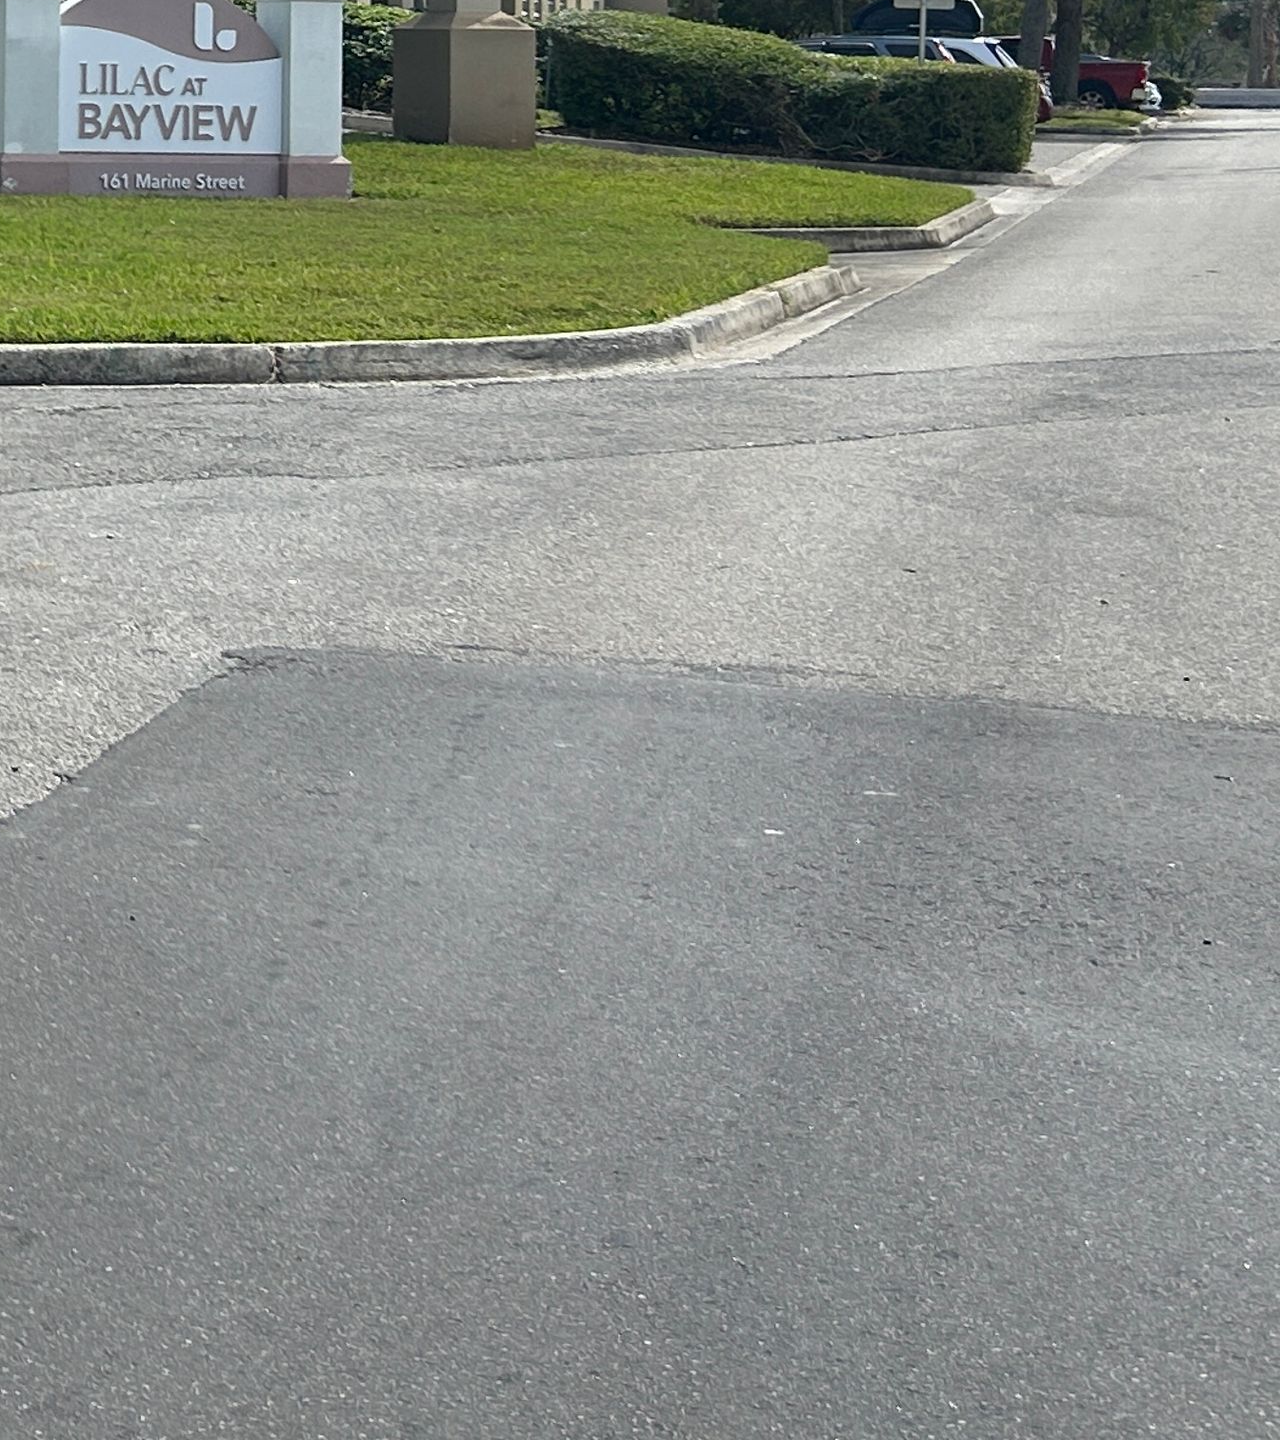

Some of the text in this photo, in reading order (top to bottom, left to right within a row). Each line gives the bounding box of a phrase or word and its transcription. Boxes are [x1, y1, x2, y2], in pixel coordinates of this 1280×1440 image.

[79, 62, 208, 97] LILAC AT
[77, 102, 258, 142] BAYVIEW
[100, 172, 246, 190] 161 Marine Street
